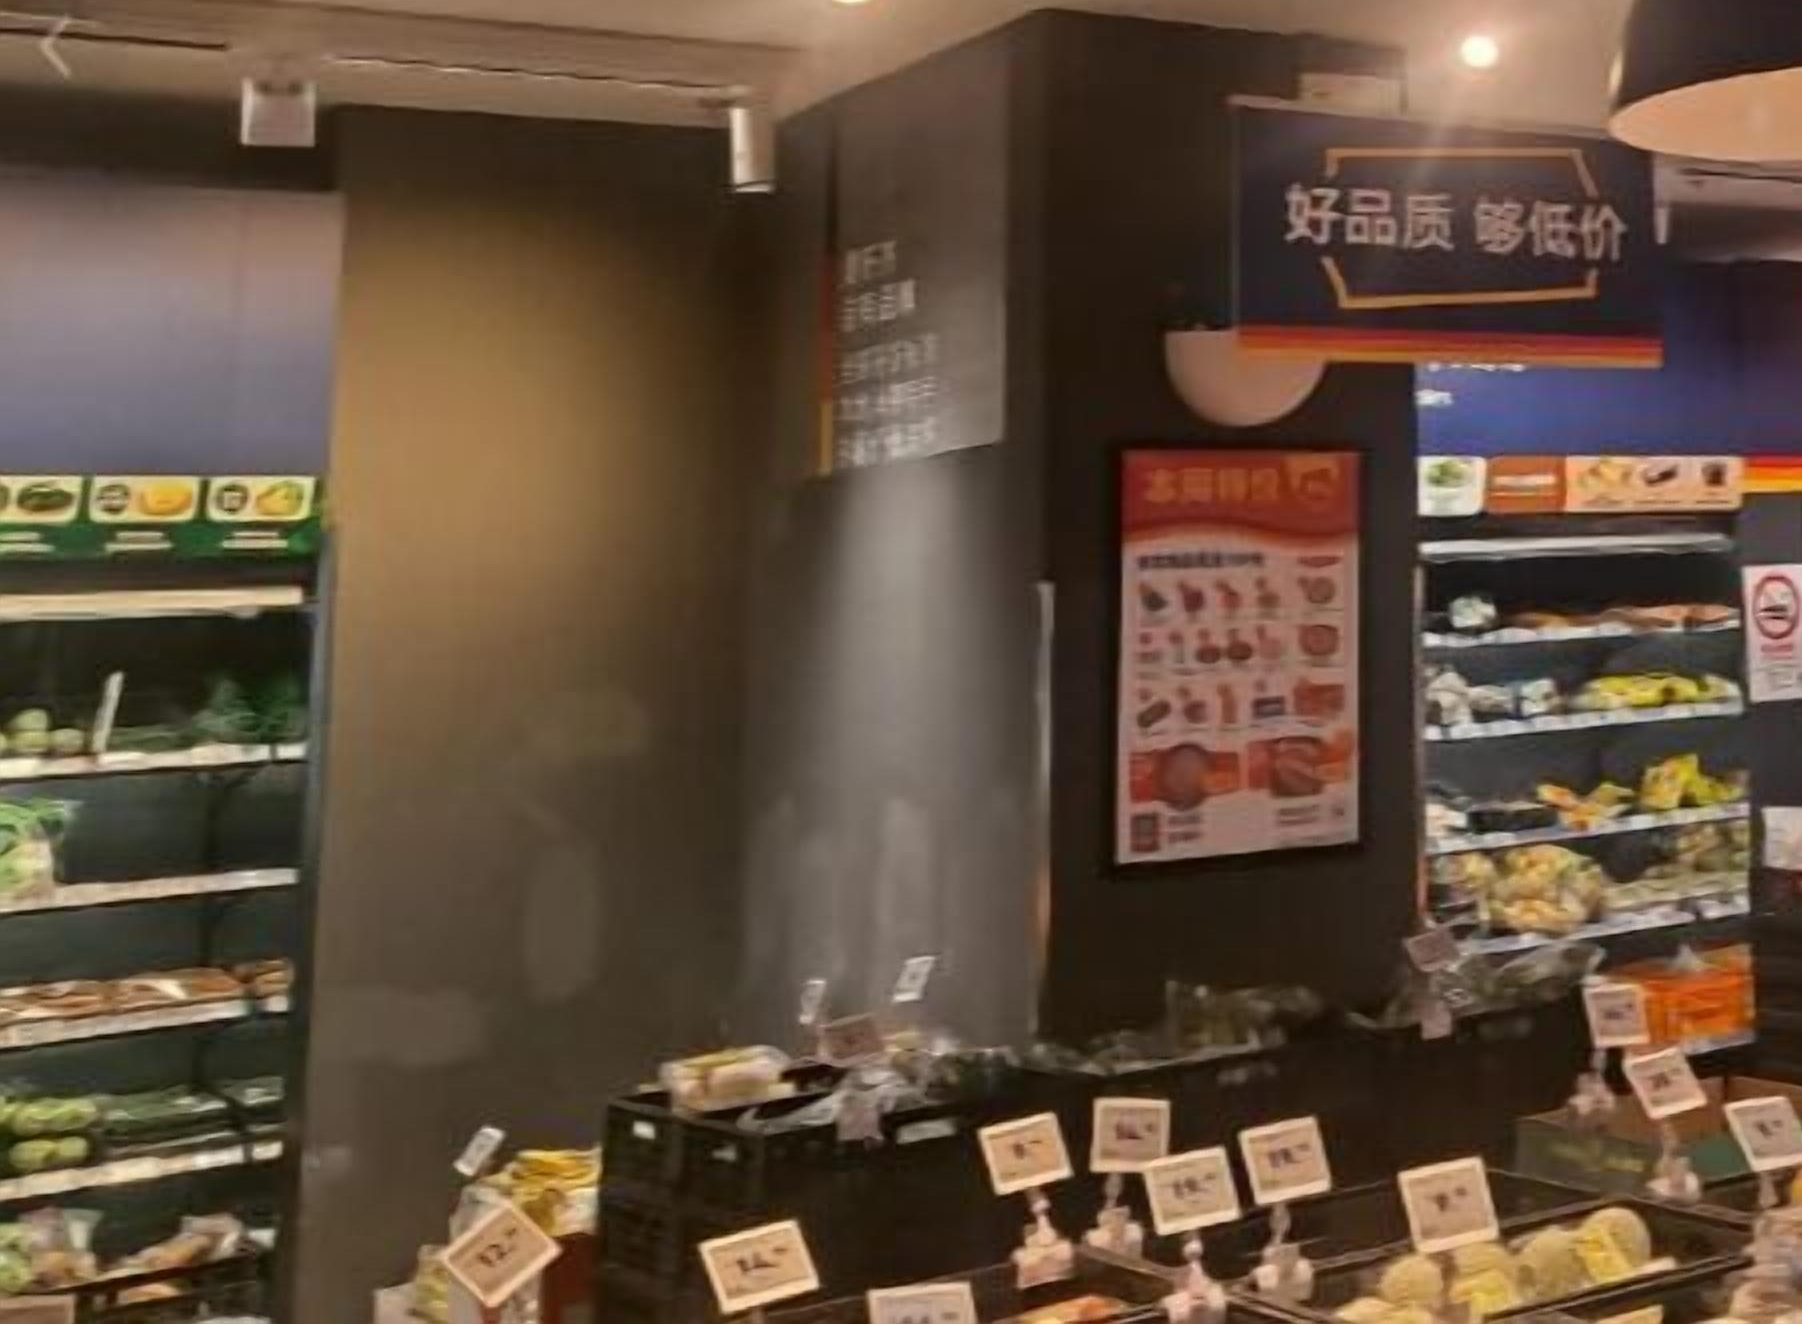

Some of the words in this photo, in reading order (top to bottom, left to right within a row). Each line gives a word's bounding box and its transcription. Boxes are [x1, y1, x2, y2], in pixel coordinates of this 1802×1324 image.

[1284, 182, 1455, 252] 好品质
[1472, 195, 1628, 262] 够低价
